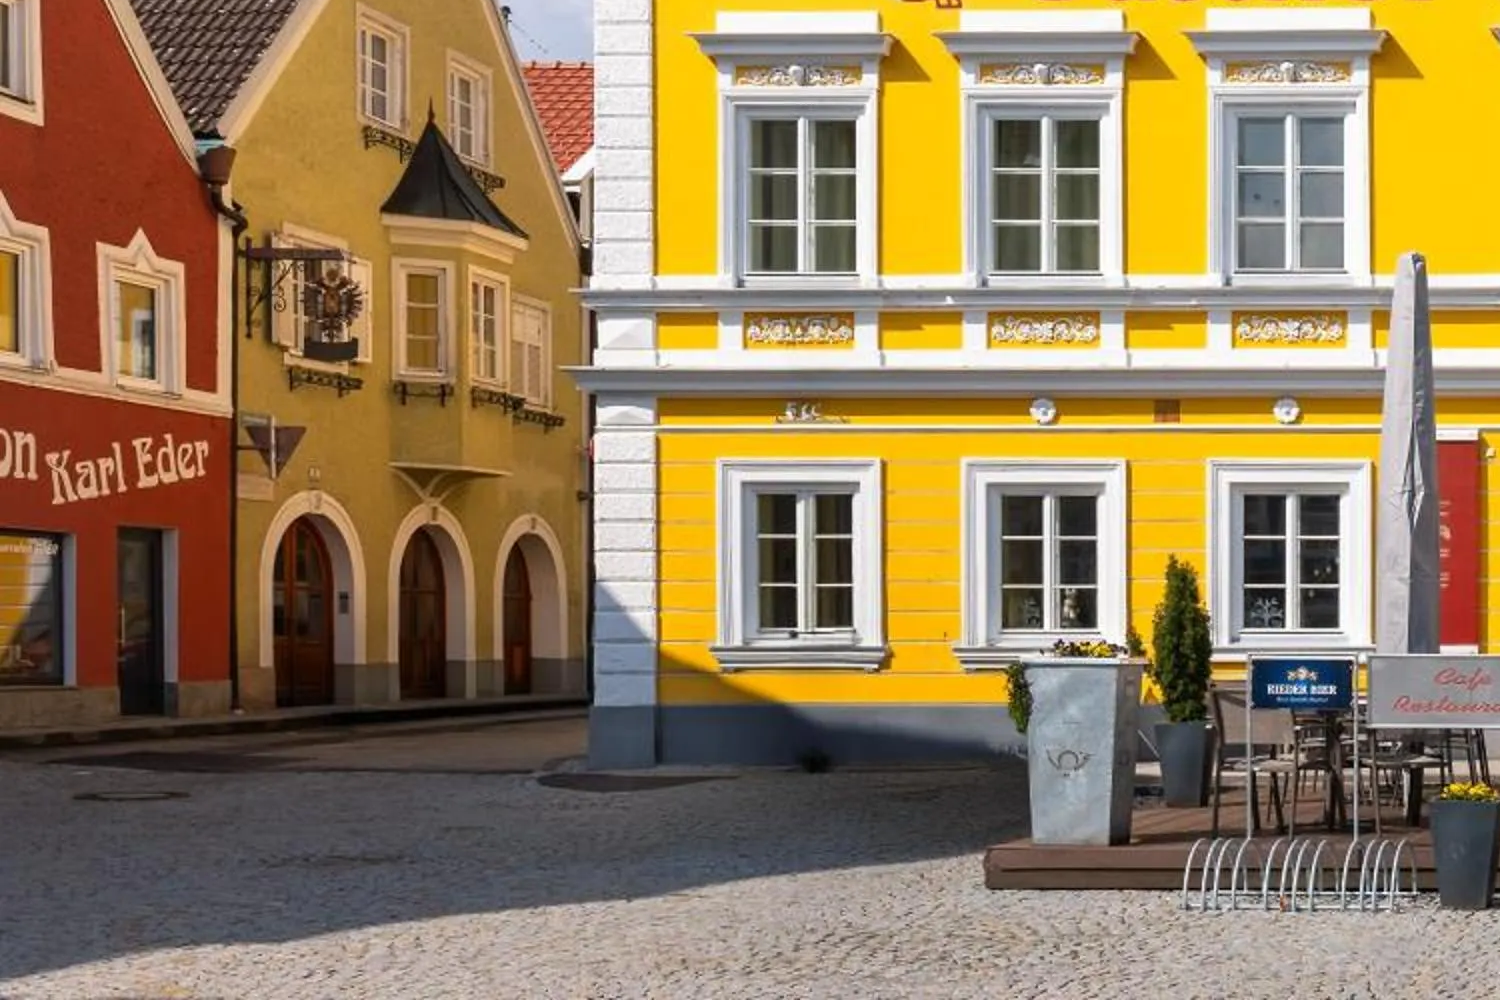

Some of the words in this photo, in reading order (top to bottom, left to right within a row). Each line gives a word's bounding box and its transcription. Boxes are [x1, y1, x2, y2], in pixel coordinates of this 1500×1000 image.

[45, 442, 127, 504] Karl
[132, 434, 209, 489] Eder
[1267, 683, 1308, 695] RIEDER
[1310, 684, 1337, 695] BIER
